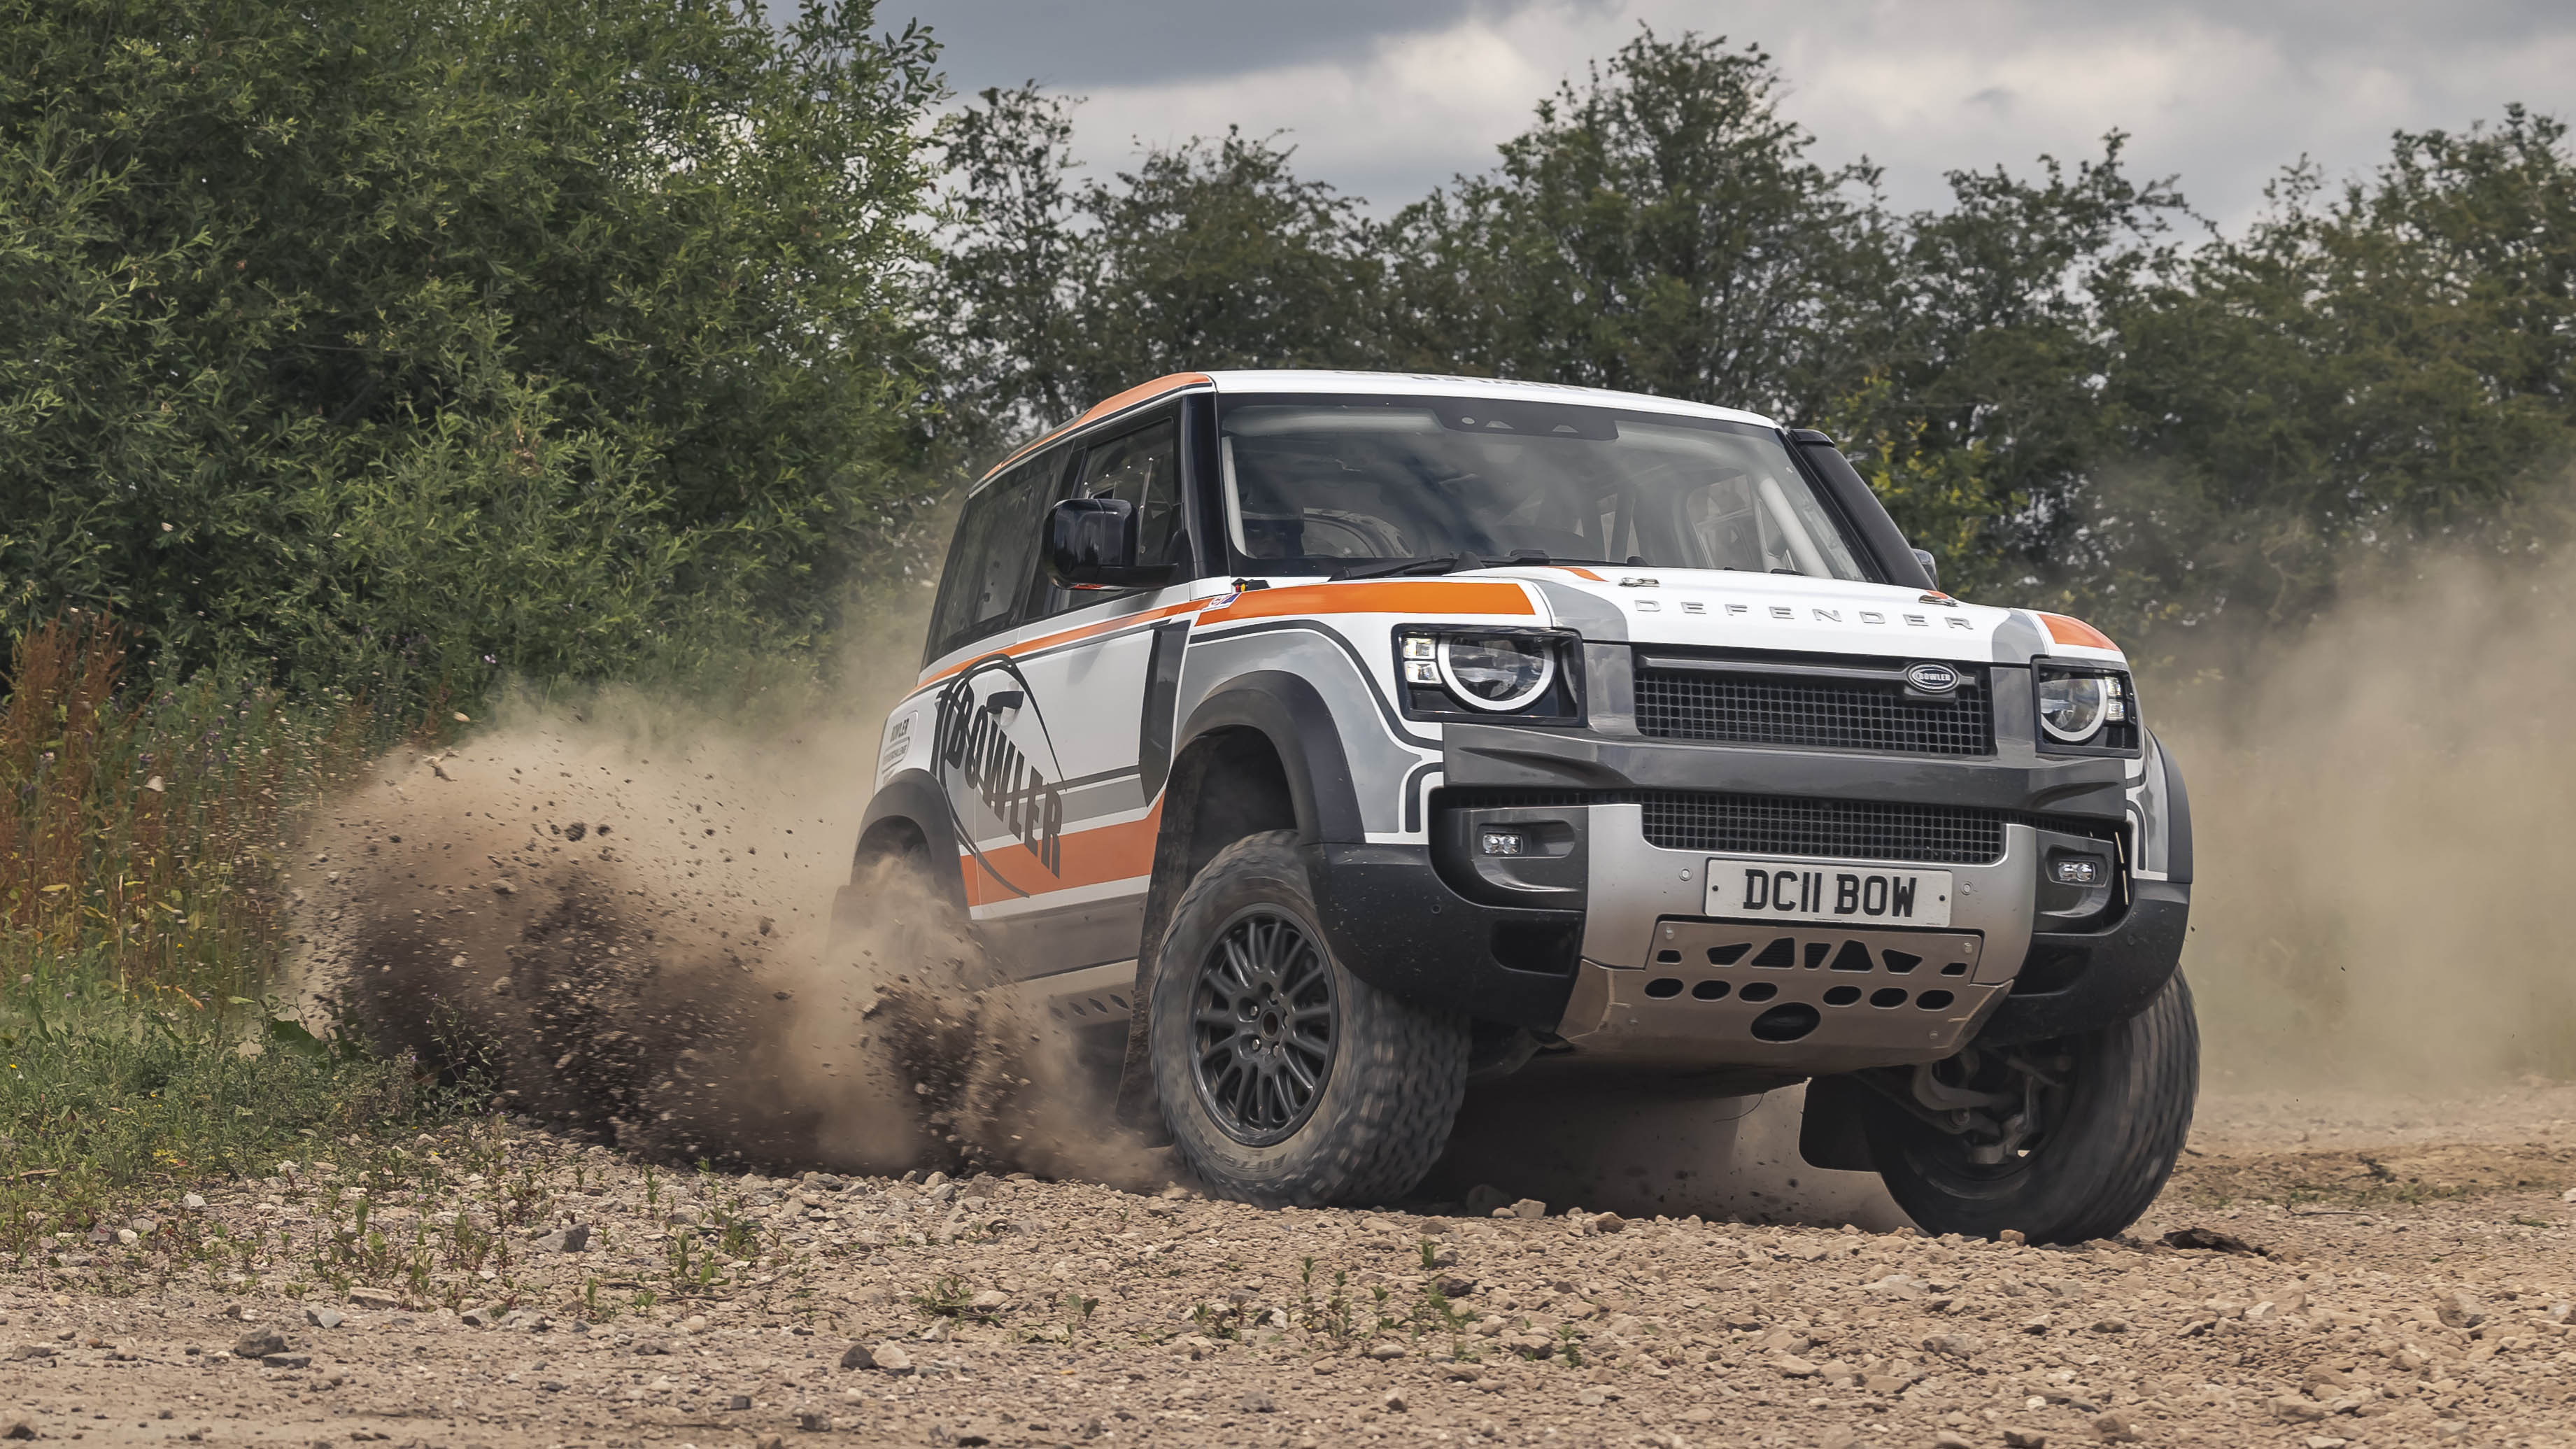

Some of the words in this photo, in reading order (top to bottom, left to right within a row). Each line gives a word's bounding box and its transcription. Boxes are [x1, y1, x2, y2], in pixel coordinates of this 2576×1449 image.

[1634, 600, 1974, 630] DEFENDER
[1917, 672, 1951, 681] BOWLER
[946, 681, 1063, 879] BOWLER
[1743, 868, 1823, 913] DC11
[1834, 873, 1917, 918] BOW
